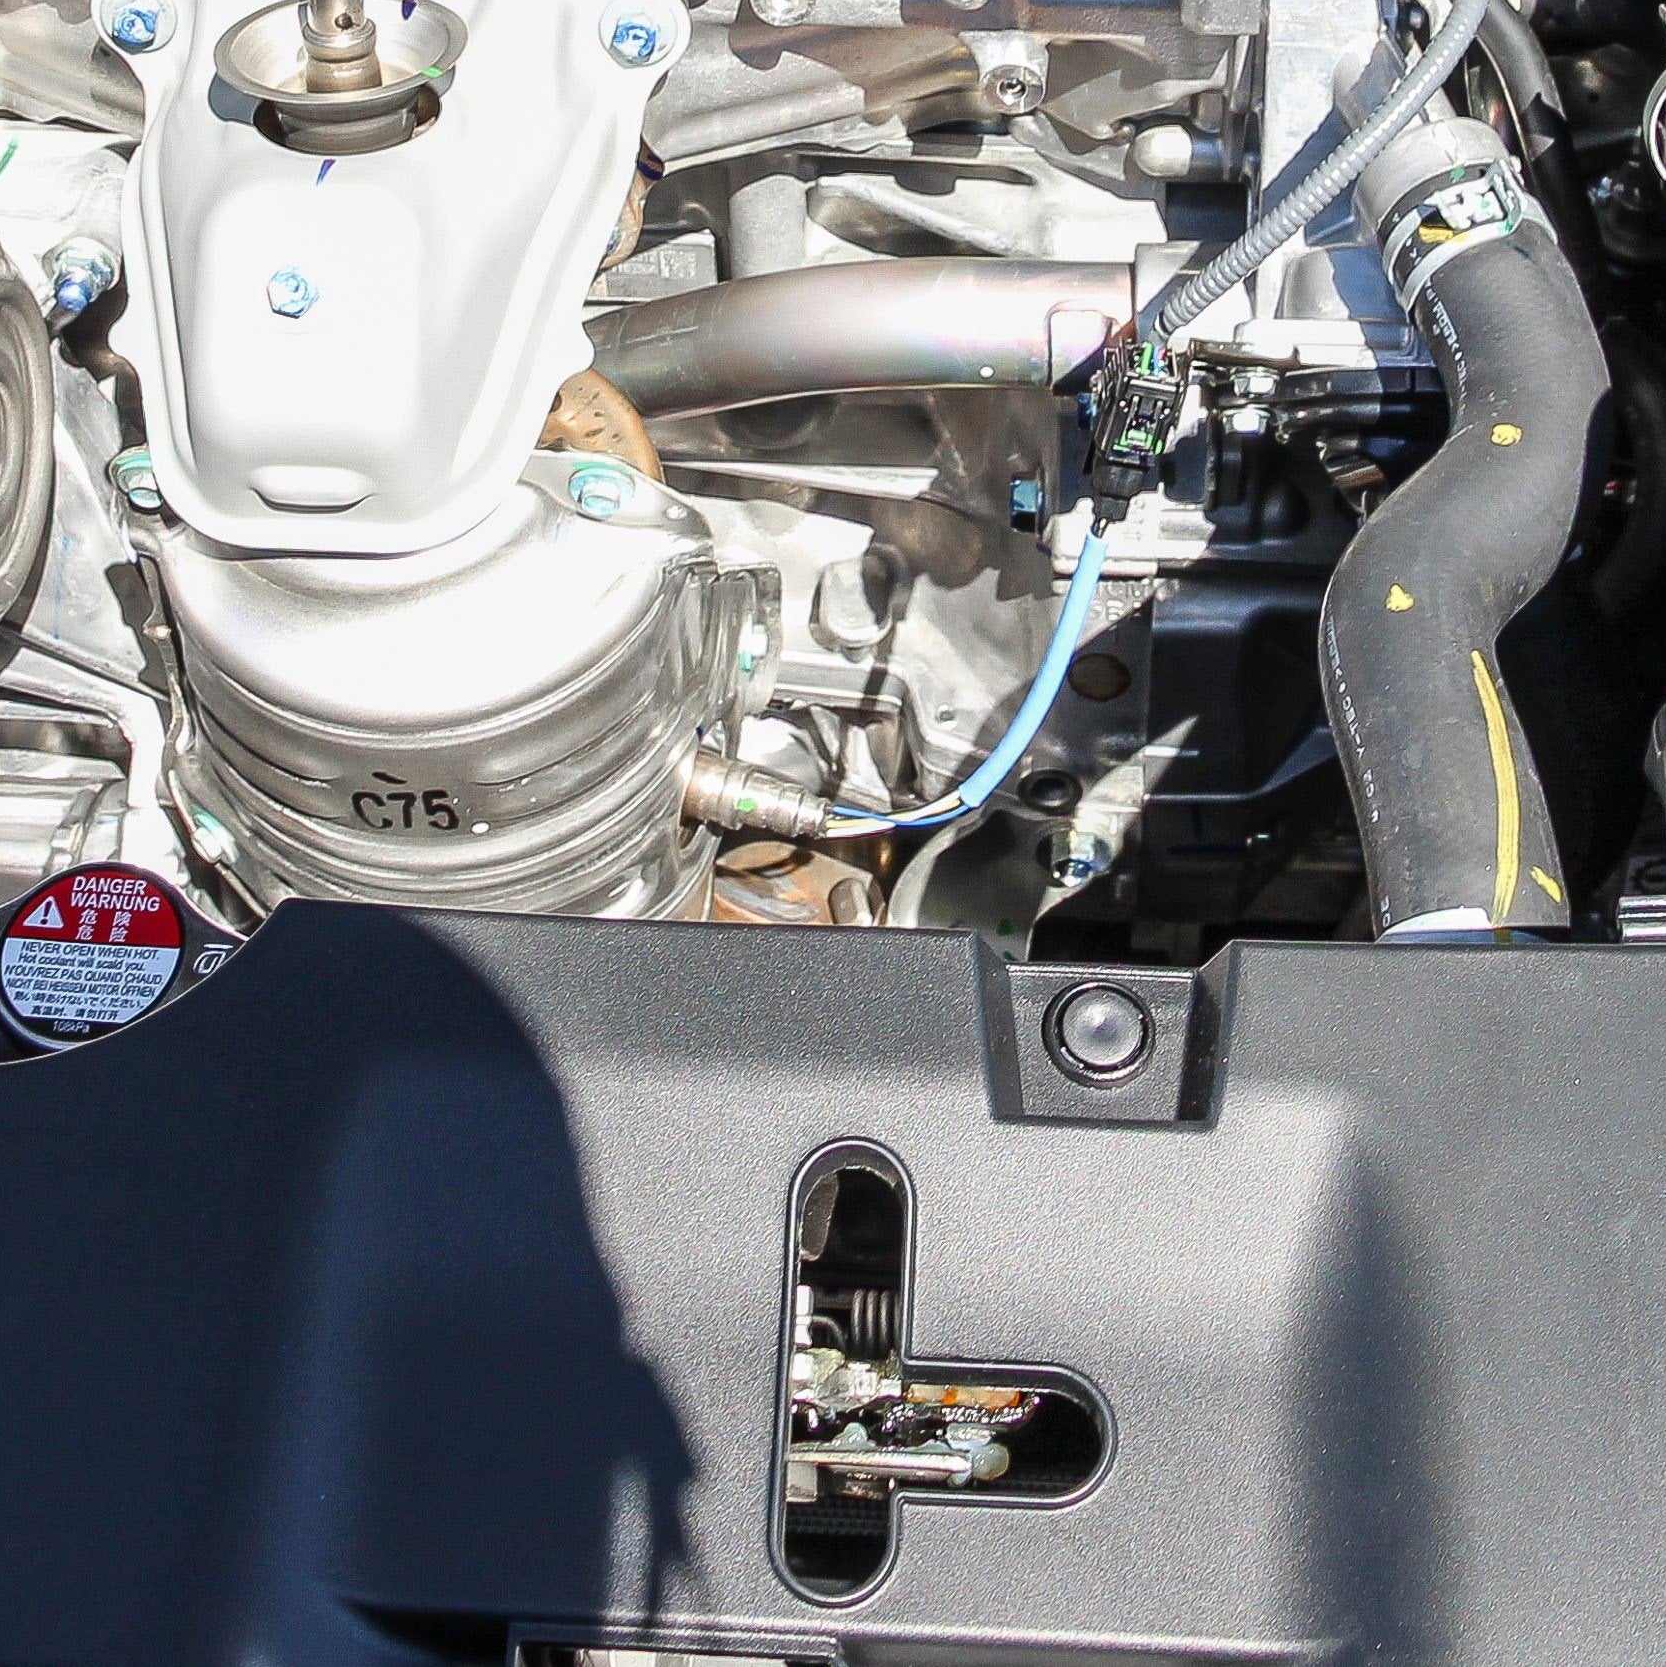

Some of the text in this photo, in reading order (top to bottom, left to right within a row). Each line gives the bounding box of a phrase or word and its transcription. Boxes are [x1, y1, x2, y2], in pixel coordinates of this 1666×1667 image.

[352, 789, 460, 830] C75
[72, 876, 147, 895] DANGER
[70, 892, 161, 912] WARNUNG
[18, 953, 37, 963] Hot
[20, 941, 161, 960] NEVER OPEN WHEN HOT.
[61, 969, 83, 981] PAS
[85, 970, 123, 983] QUAND
